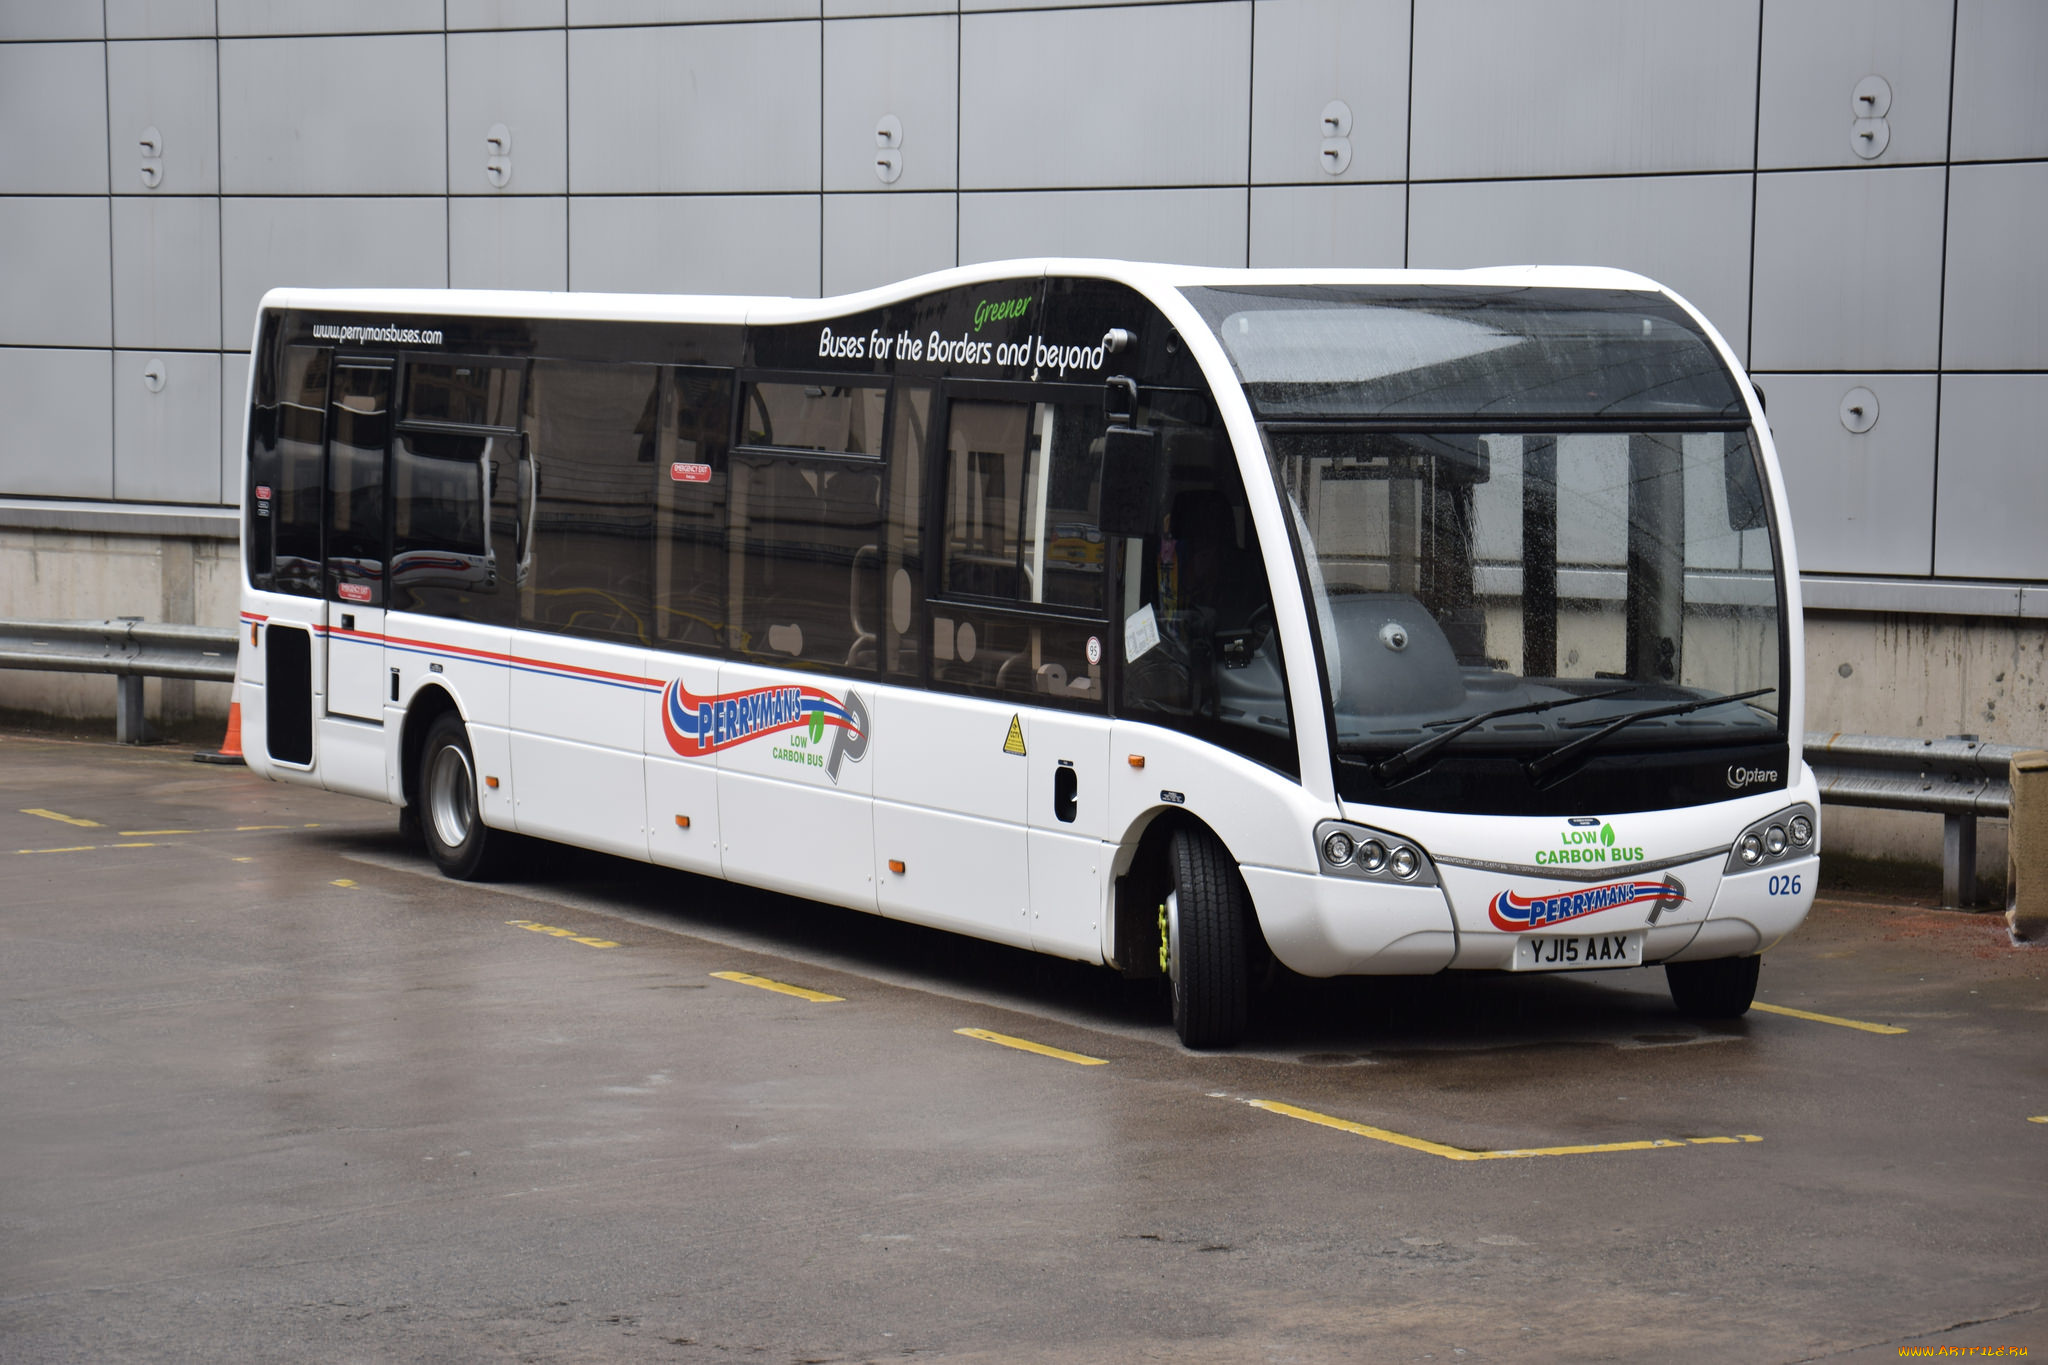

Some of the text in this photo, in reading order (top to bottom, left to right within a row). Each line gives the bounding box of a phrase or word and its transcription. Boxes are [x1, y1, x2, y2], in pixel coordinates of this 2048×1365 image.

[974, 296, 1031, 332] Greener
[312, 323, 443, 345] www.perrymansbuses.com
[818, 326, 1105, 378] Buses for the Borders and beyond
[1089, 645, 1098, 657] 95
[697, 687, 802, 749] PERRYMAN'S
[790, 734, 808, 749] LOW
[772, 747, 824, 768] CARBON BUS
[1733, 766, 1778, 787] Optare
[1560, 830, 1598, 845] LOW
[1535, 846, 1644, 865] CARBON BUS
[1768, 874, 1802, 896] 026
[1528, 883, 1636, 927] PERRYMAN'S
[1531, 936, 1627, 963] YJ15 AAX
